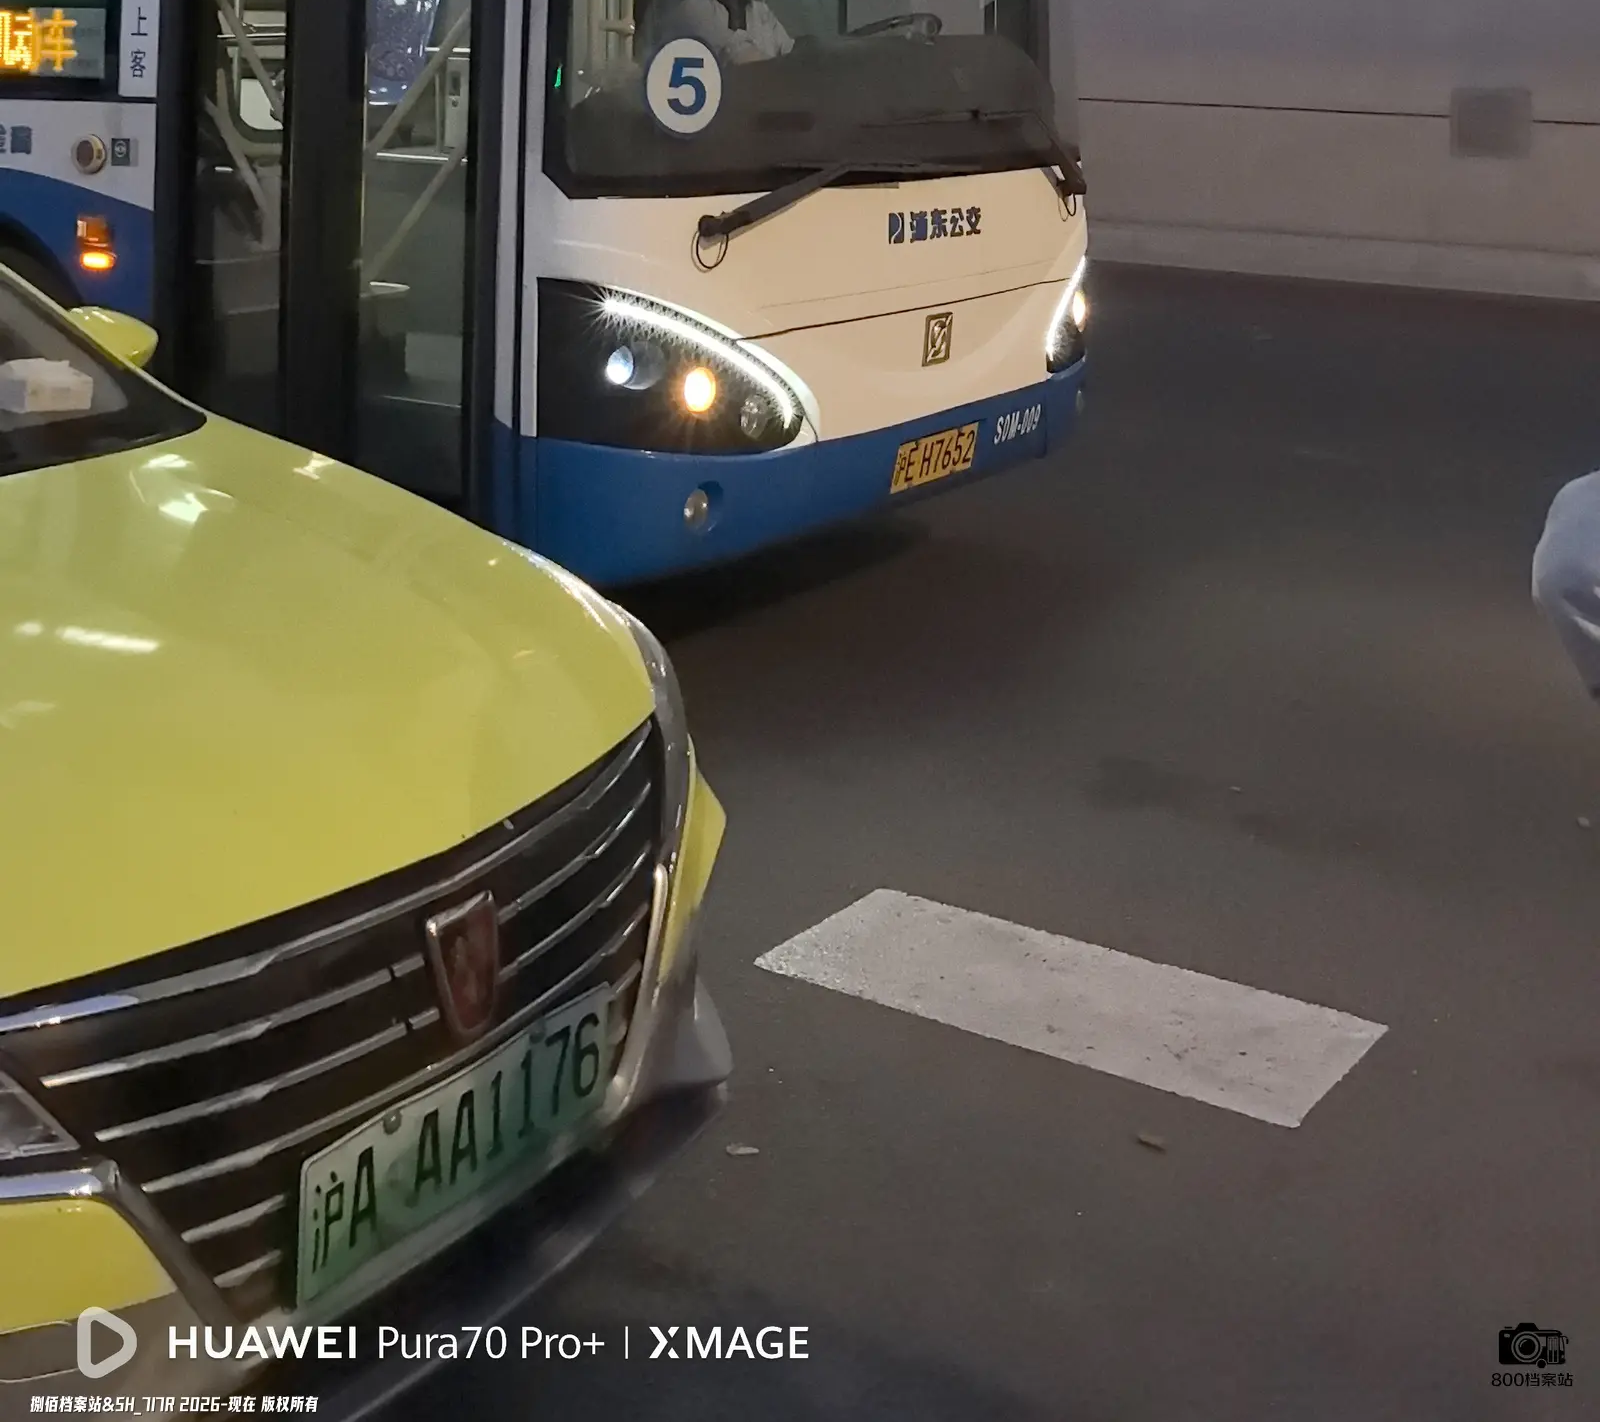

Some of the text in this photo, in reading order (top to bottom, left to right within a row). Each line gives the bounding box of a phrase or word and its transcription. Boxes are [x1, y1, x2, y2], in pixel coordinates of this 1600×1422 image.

[667, 57, 707, 116] 5
[909, 206, 981, 243] 浦东公交
